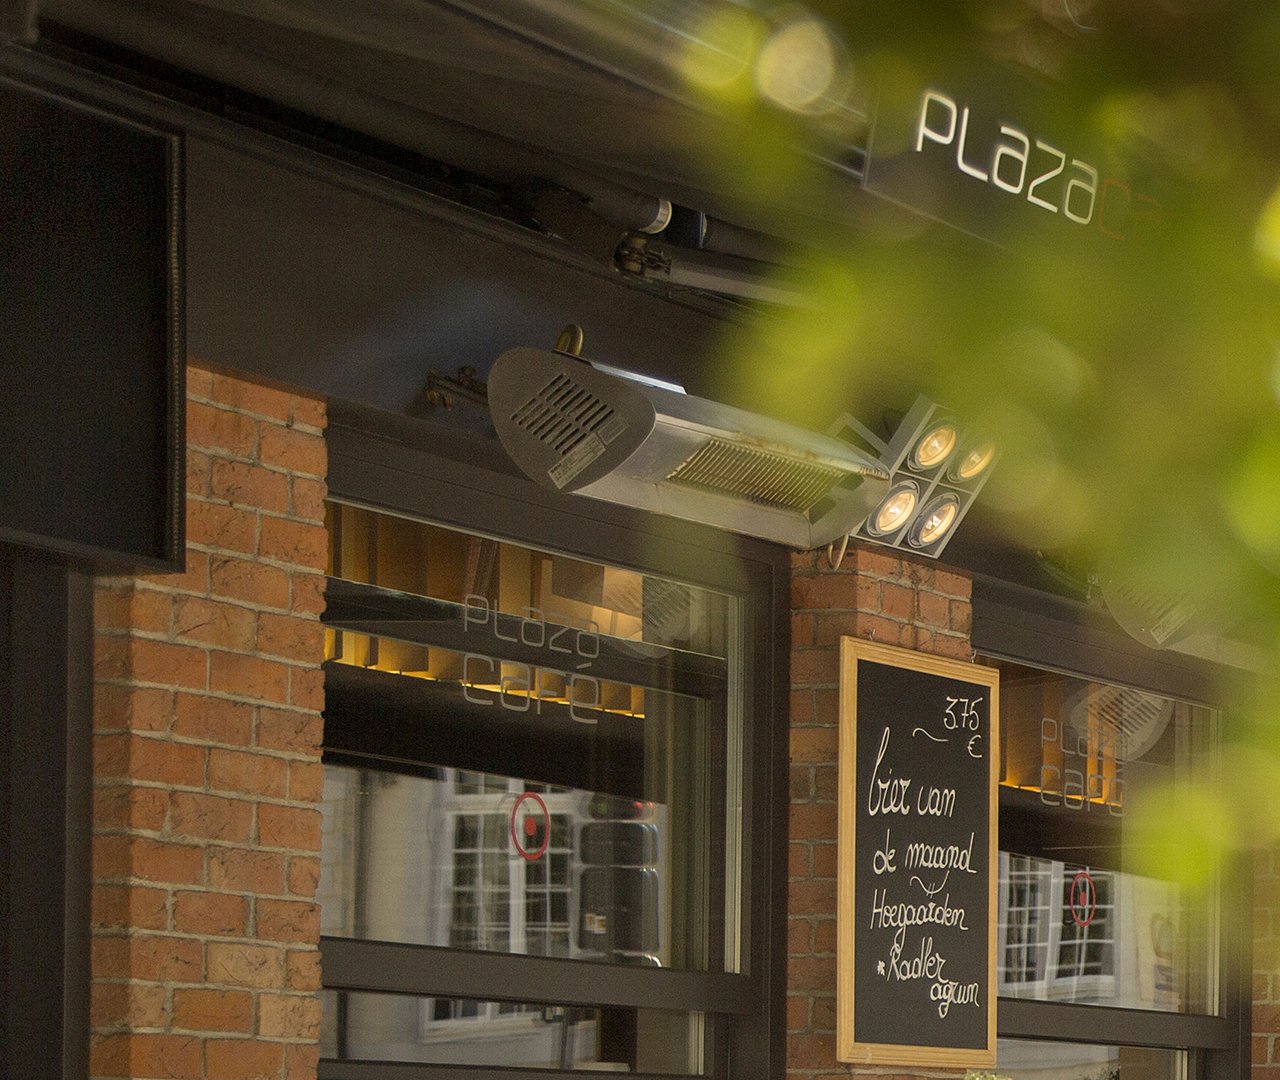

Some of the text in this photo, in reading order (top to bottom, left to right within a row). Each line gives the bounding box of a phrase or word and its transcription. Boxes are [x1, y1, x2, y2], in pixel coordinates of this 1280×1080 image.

[967, 734, 983, 758] €
[868, 726, 957, 818] bier van
[872, 828, 978, 875] de maand
[869, 888, 969, 951] Hoegaarden
[886, 936, 949, 984] Radler
